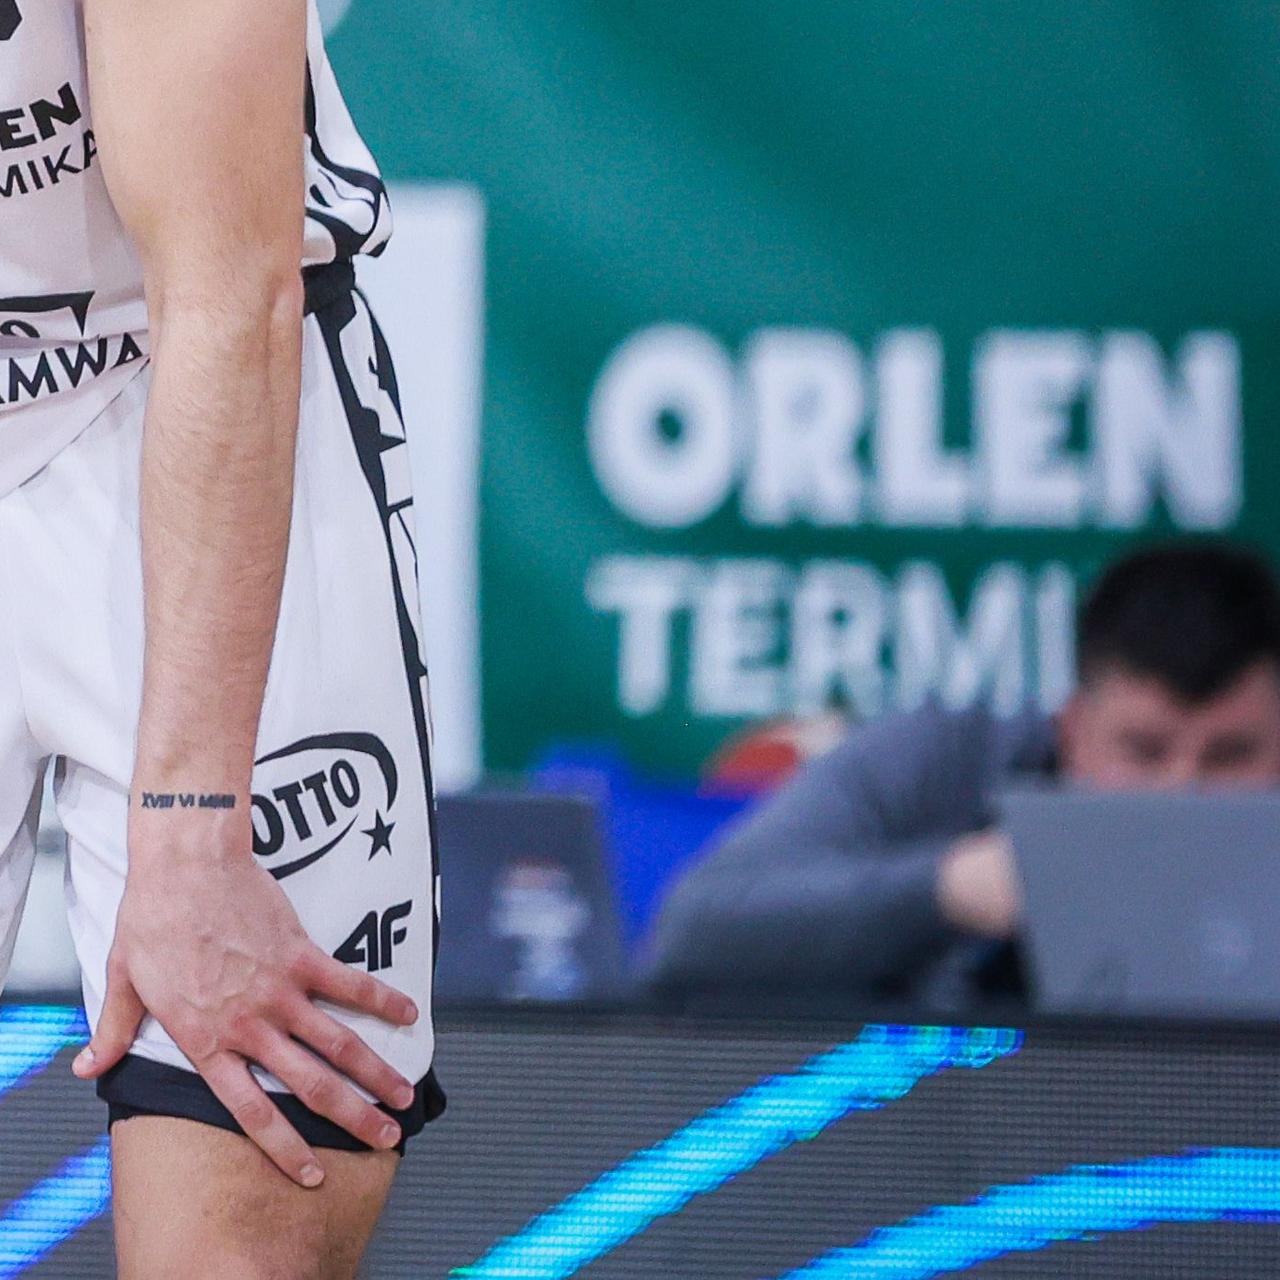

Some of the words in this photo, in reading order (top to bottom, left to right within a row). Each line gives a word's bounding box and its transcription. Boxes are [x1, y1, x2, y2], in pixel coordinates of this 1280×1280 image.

[586, 322, 1242, 526] ORLEN
[586, 555, 1078, 718] TERMI
[251, 758, 360, 856] OTTO
[332, 899, 413, 972] 4F
